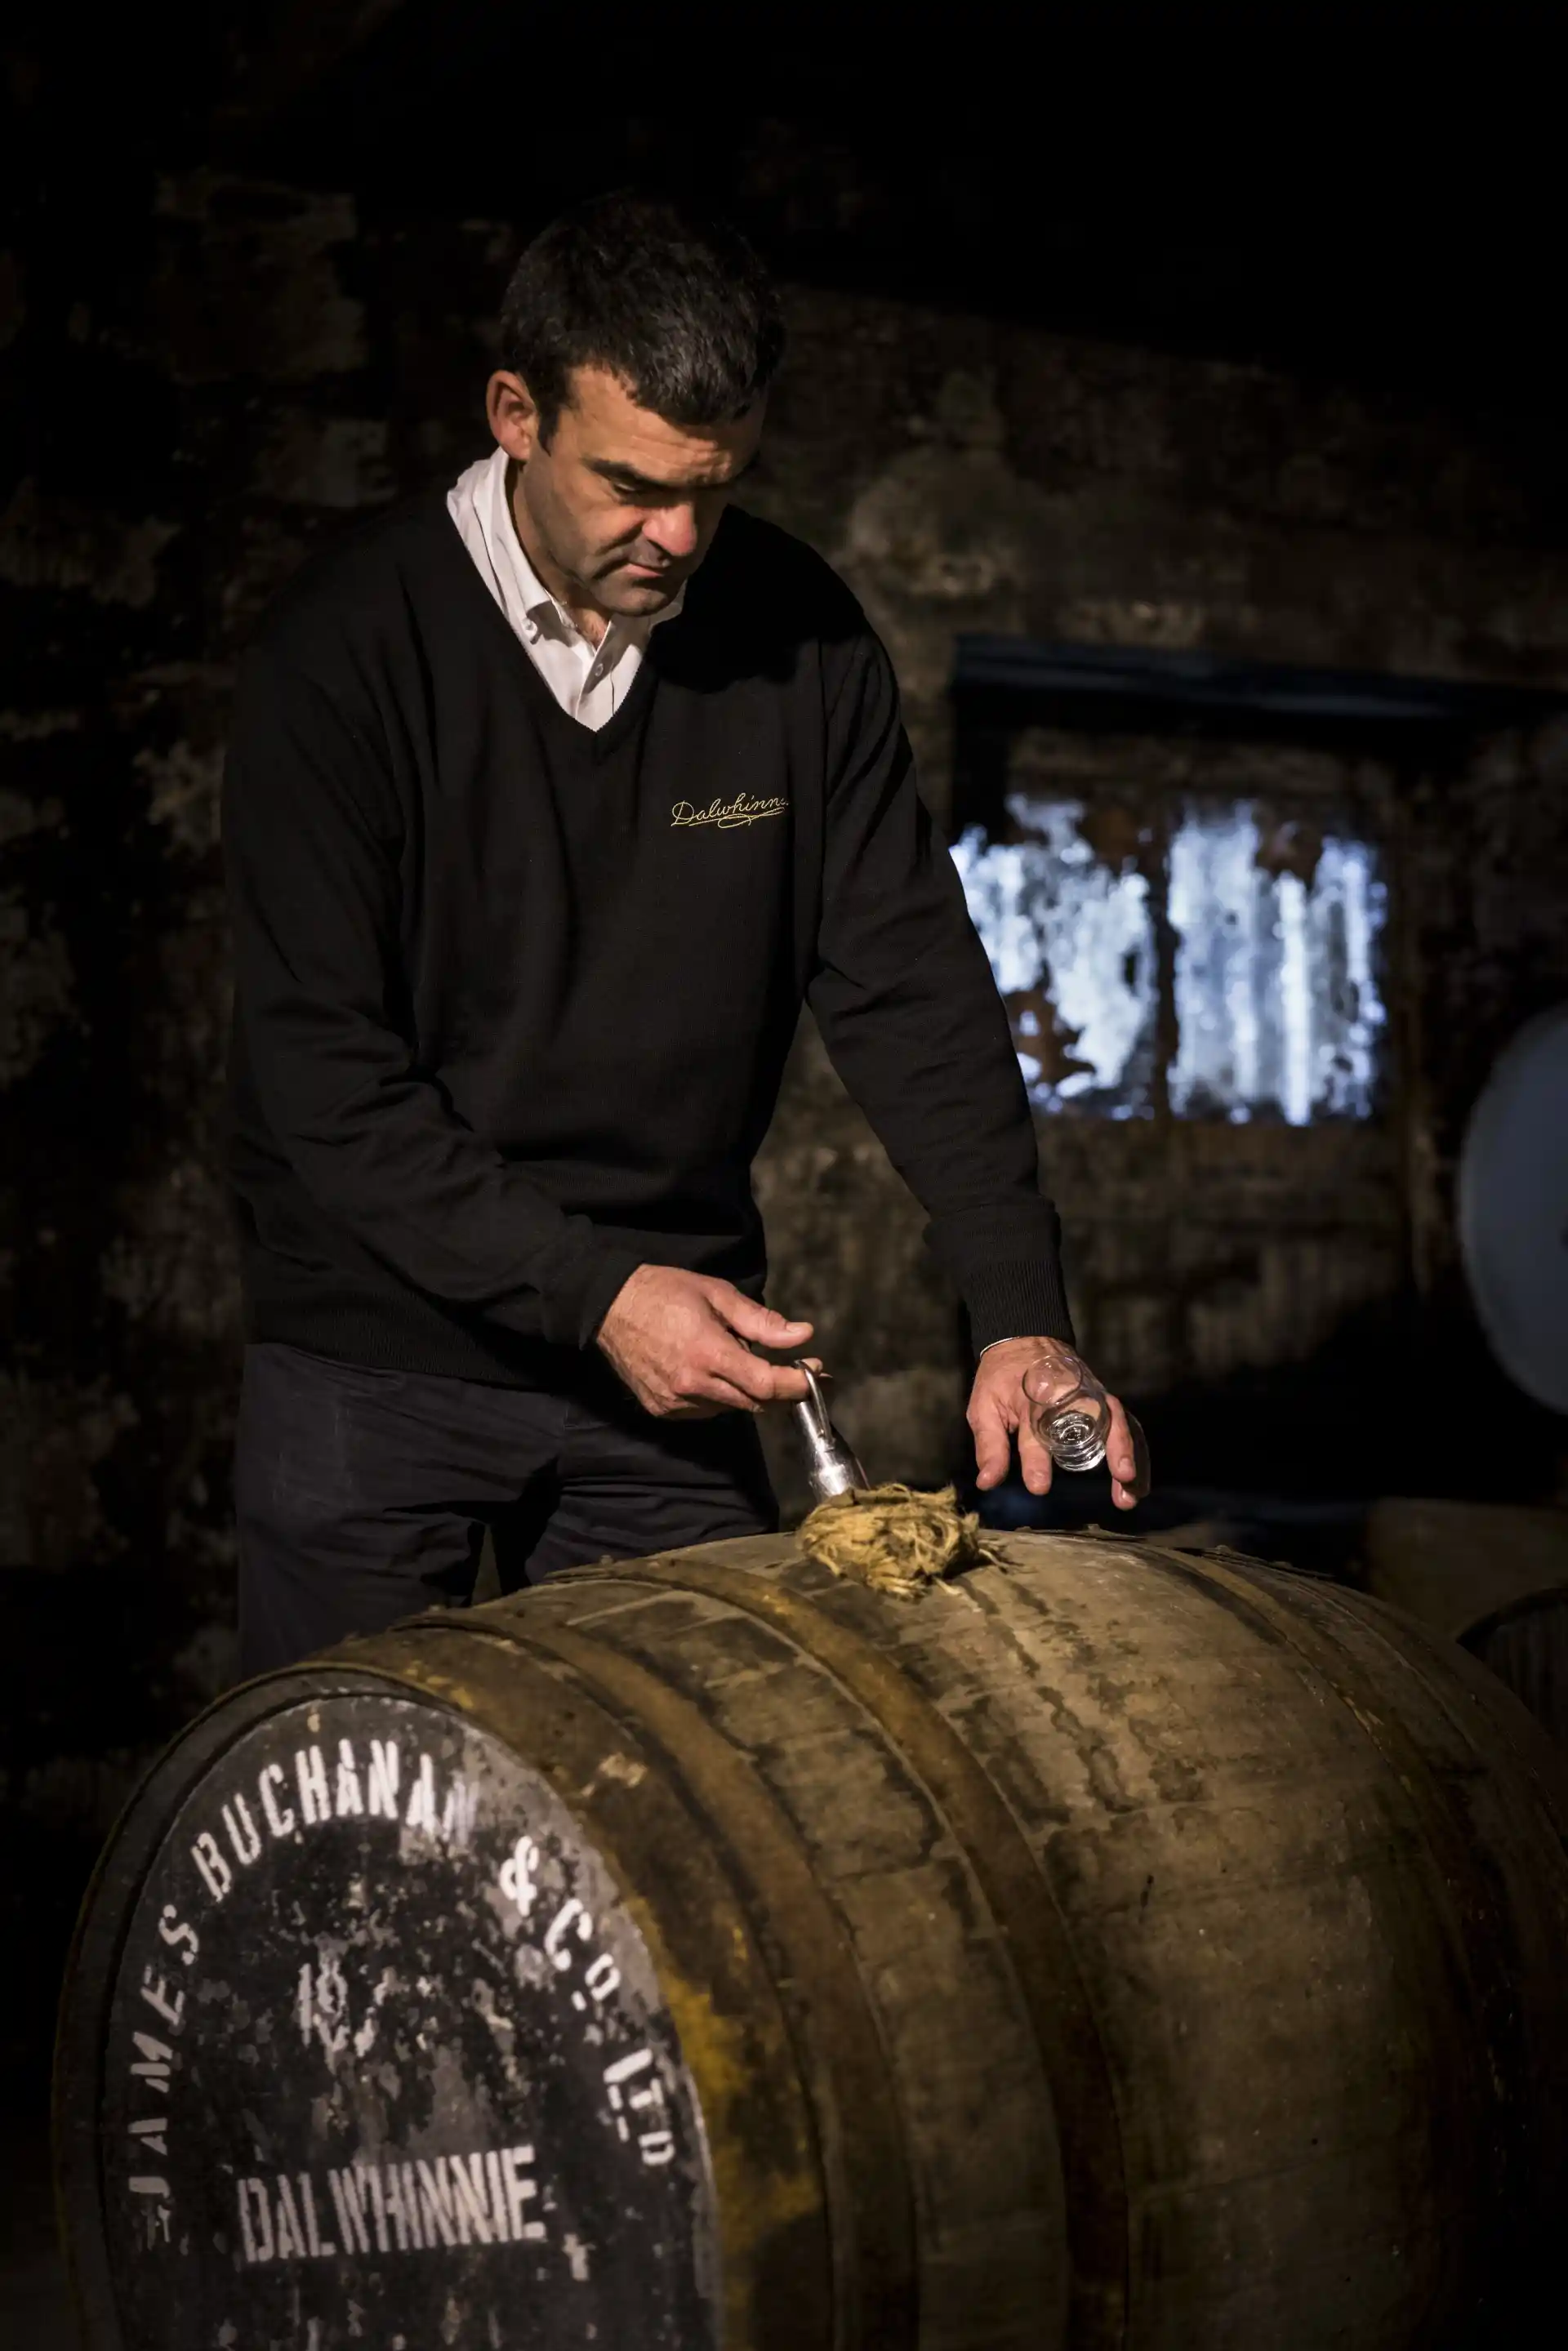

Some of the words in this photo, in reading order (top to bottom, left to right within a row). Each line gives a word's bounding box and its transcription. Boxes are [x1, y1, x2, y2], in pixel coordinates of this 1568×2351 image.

[127, 1904, 200, 2244] JAMES
[190, 1738, 480, 1903] BUCHANAN
[500, 1836, 539, 1917] &
[237, 2144, 546, 2264] DALWHINNIE
